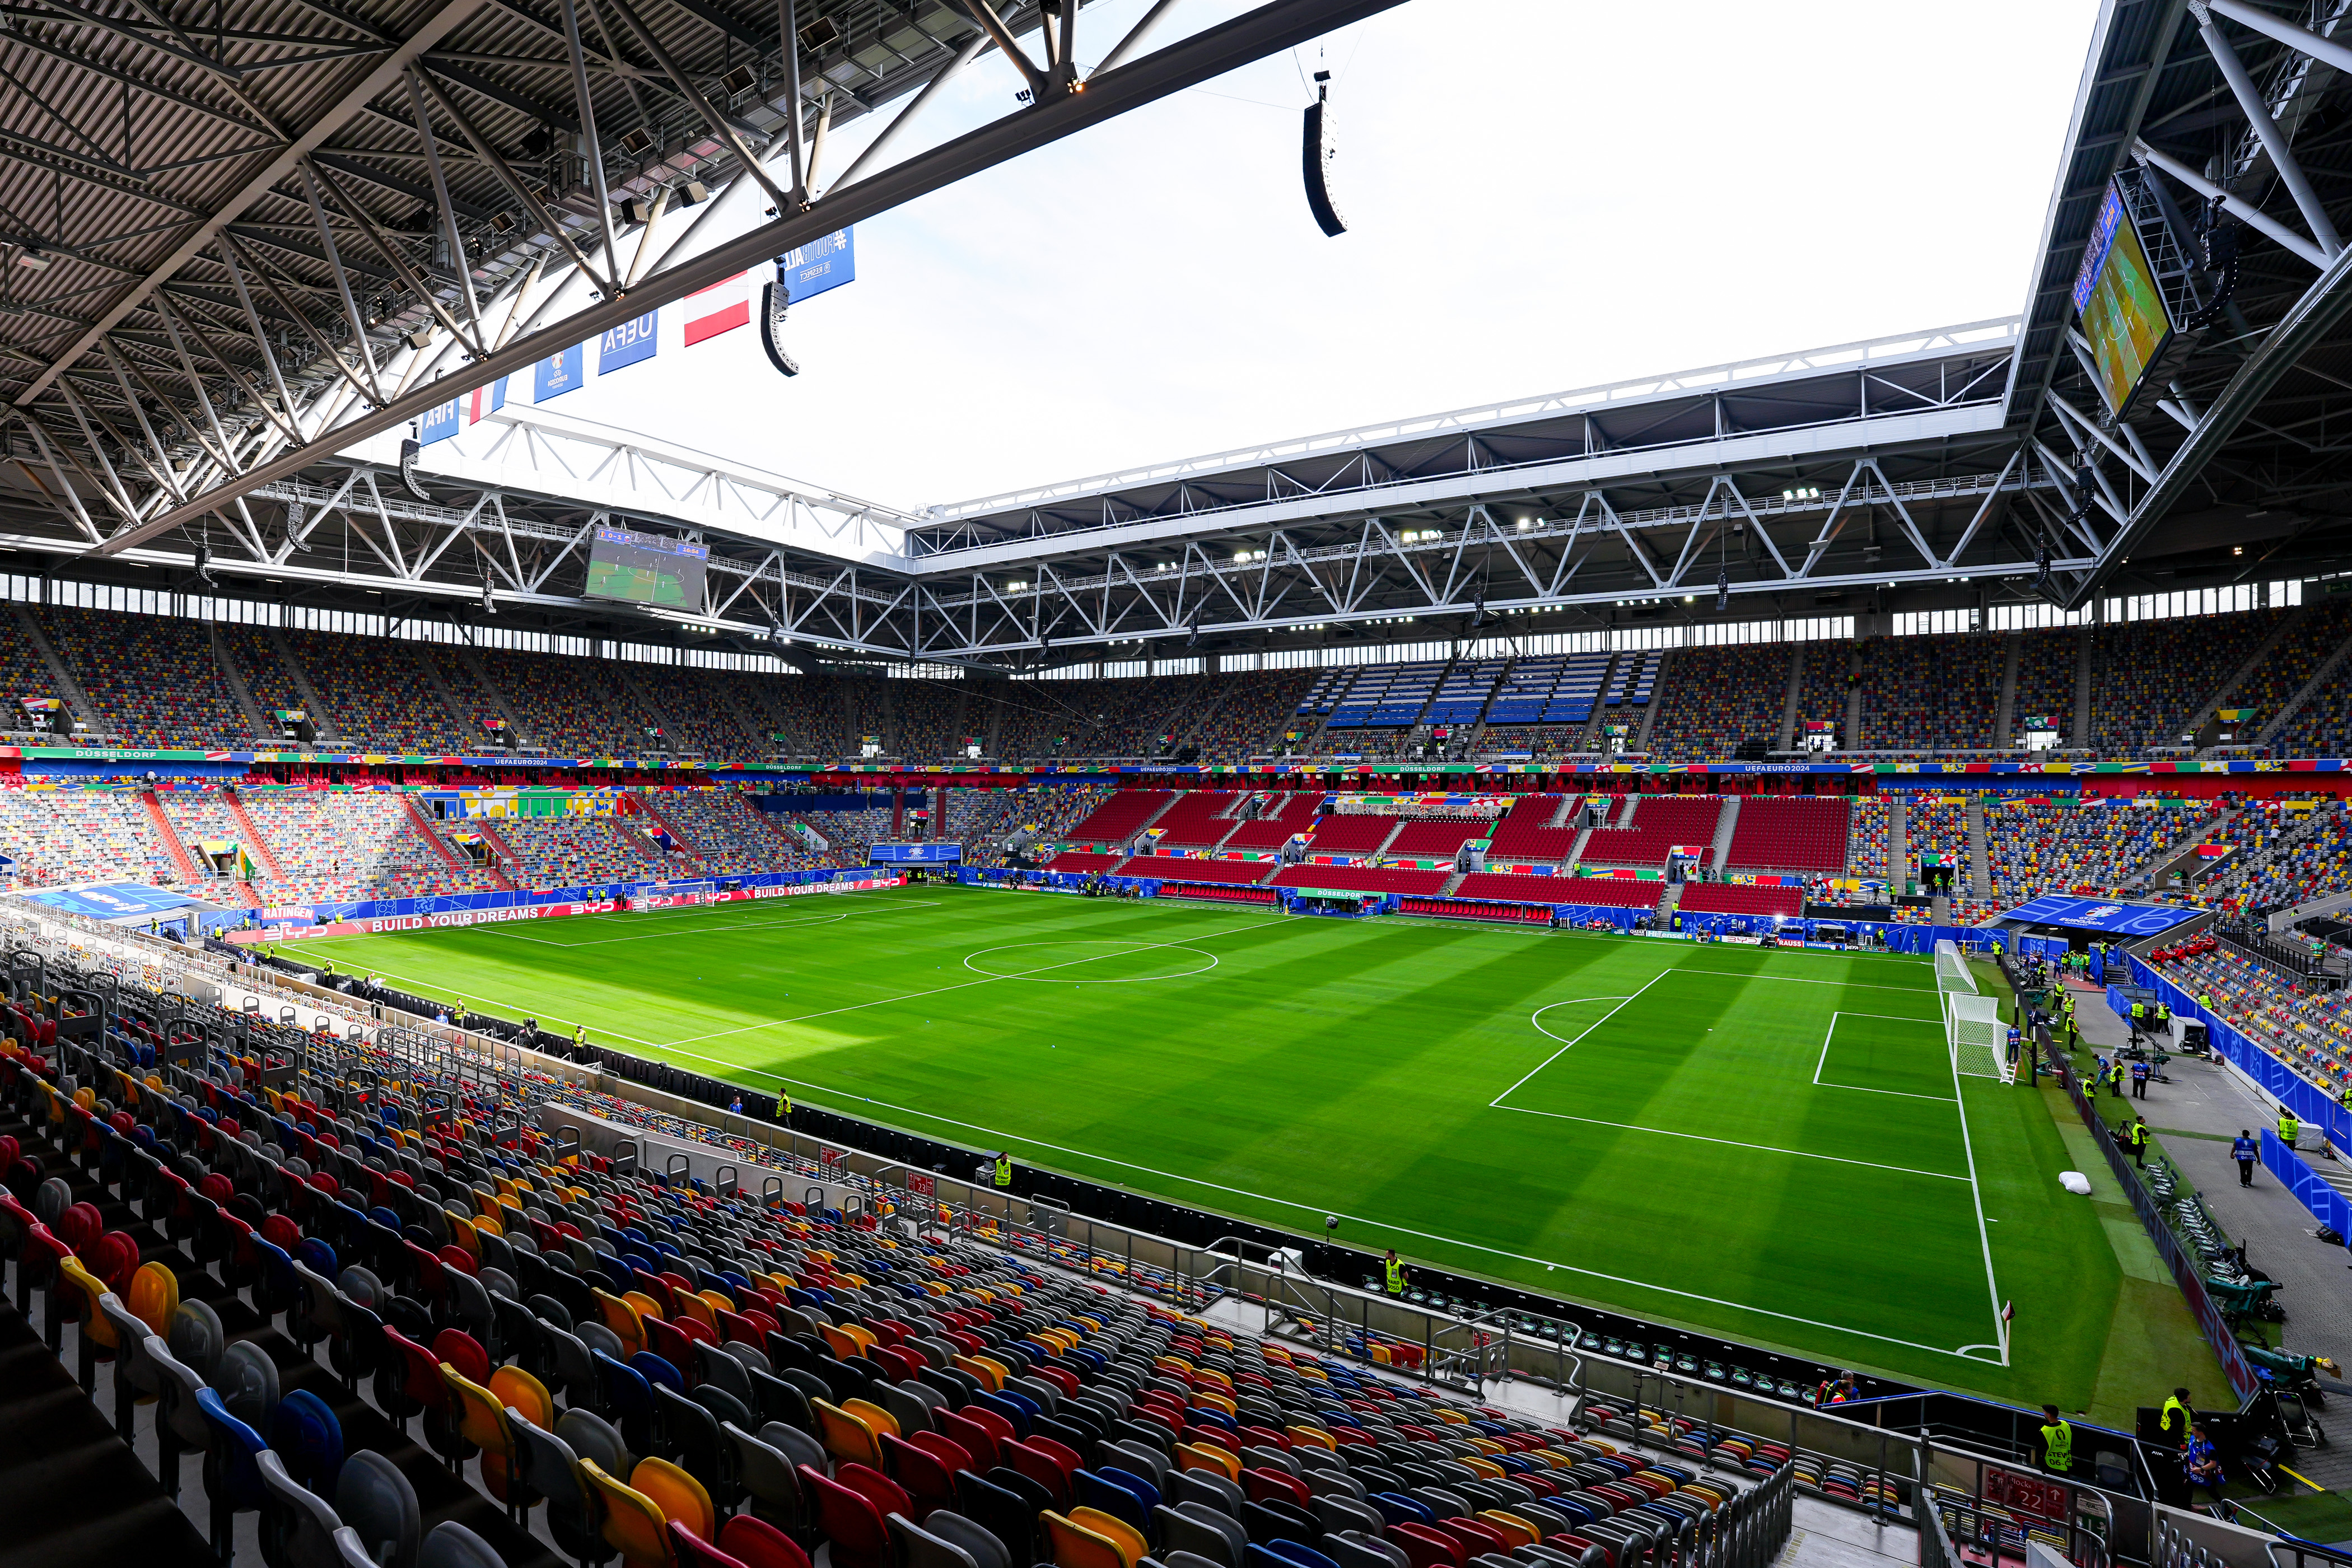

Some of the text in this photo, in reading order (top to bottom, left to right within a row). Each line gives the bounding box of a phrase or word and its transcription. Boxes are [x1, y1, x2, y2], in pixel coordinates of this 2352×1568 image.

[76, 749, 156, 758] DÜSSELDORF
[754, 878, 900, 899] BUILD YOUR DREAMS BYD
[263, 906, 314, 919] RATINGEN
[570, 902, 615, 915] BYD
[372, 908, 539, 933] BUILD YOUR DREAMS
[2059, 917, 2105, 926] EURO2024
[264, 925, 328, 942] BYD
[918, 1183, 926, 1192] 23
[2020, 1491, 2041, 1510] 22
